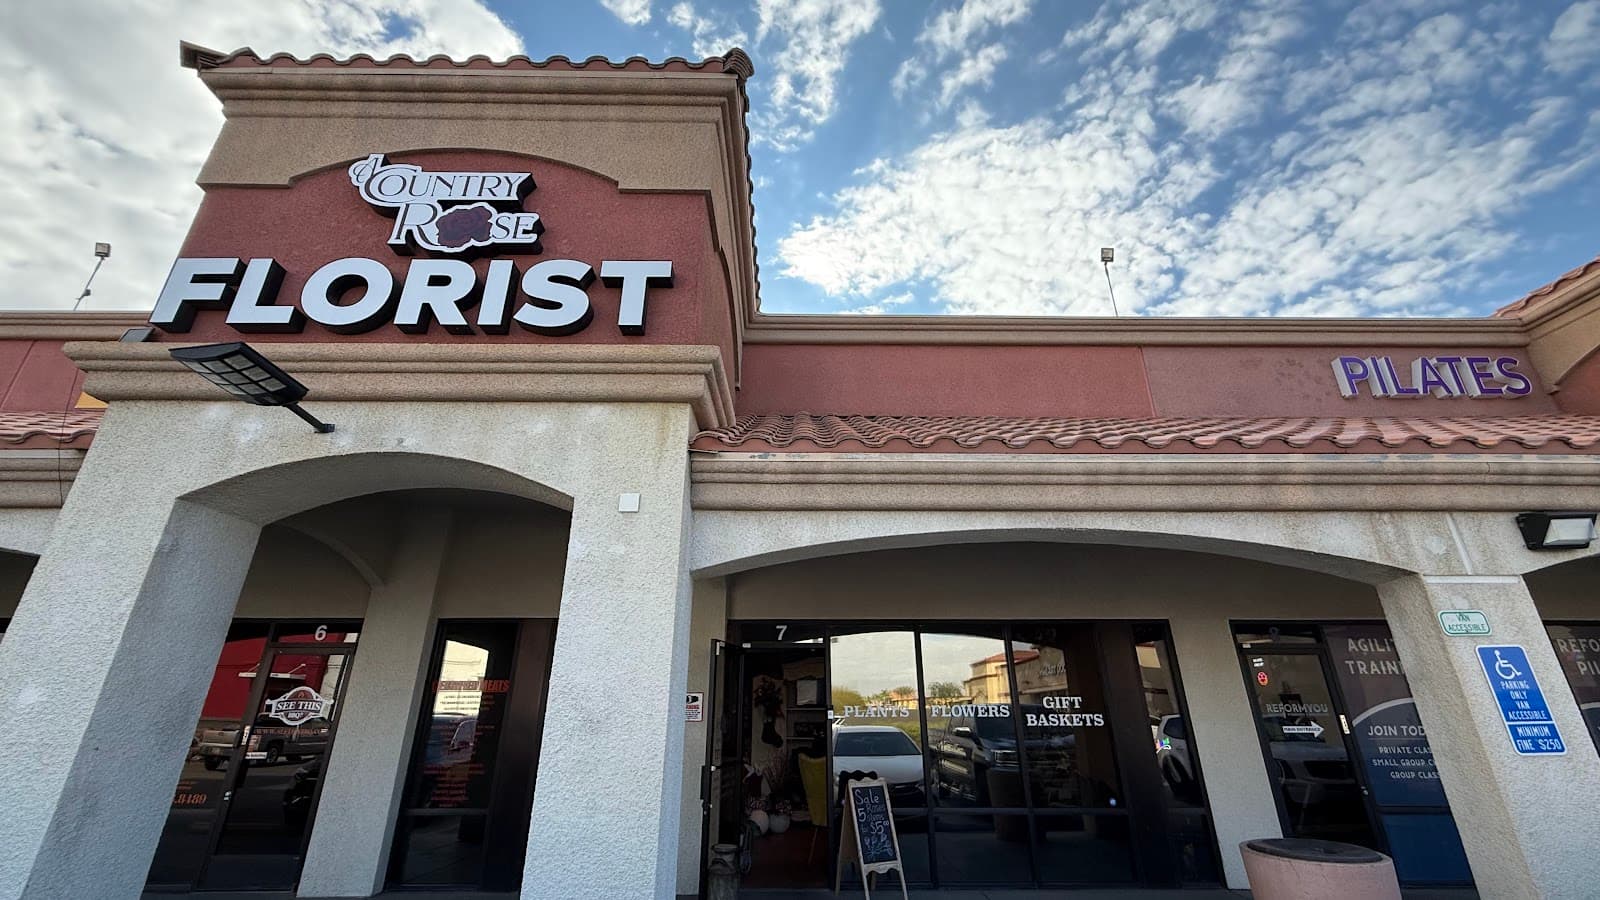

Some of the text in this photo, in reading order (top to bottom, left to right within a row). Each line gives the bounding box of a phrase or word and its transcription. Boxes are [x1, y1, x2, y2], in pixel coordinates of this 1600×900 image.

[364, 166, 523, 203] COUNTRY
[148, 257, 673, 336] FLORIST
[1333, 355, 1533, 397] PILATES
[1455, 614, 1471, 623] VAN
[1448, 623, 1487, 632] ACCESSIBLE
[314, 625, 328, 641] 6
[776, 625, 788, 641] 7
[1501, 680, 1530, 690] PARKING
[1510, 691, 1528, 699] ONLY
[276, 701, 322, 711] SEE THIS
[1042, 696, 1082, 709] GIFT
[1515, 701, 1530, 709] VAN
[843, 705, 1010, 718] PLANTS FLOWERS
[1265, 703, 1328, 713] REFORMYOU
[1026, 714, 1105, 727] BASKETS
[1508, 711, 1548, 720] ACCESSIBLE
[1368, 725, 1398, 736] JOIN
[1517, 727, 1551, 737] MINIMUM
[1379, 746, 1411, 754] PRIVATE
[1516, 740, 1535, 750] FINE
[1372, 759, 1399, 767] SMALL
[1400, 759, 1426, 767] GROUP
[1390, 771, 1416, 779] GROUP
[854, 789, 880, 805] Sale
[857, 807, 867, 822] 5
